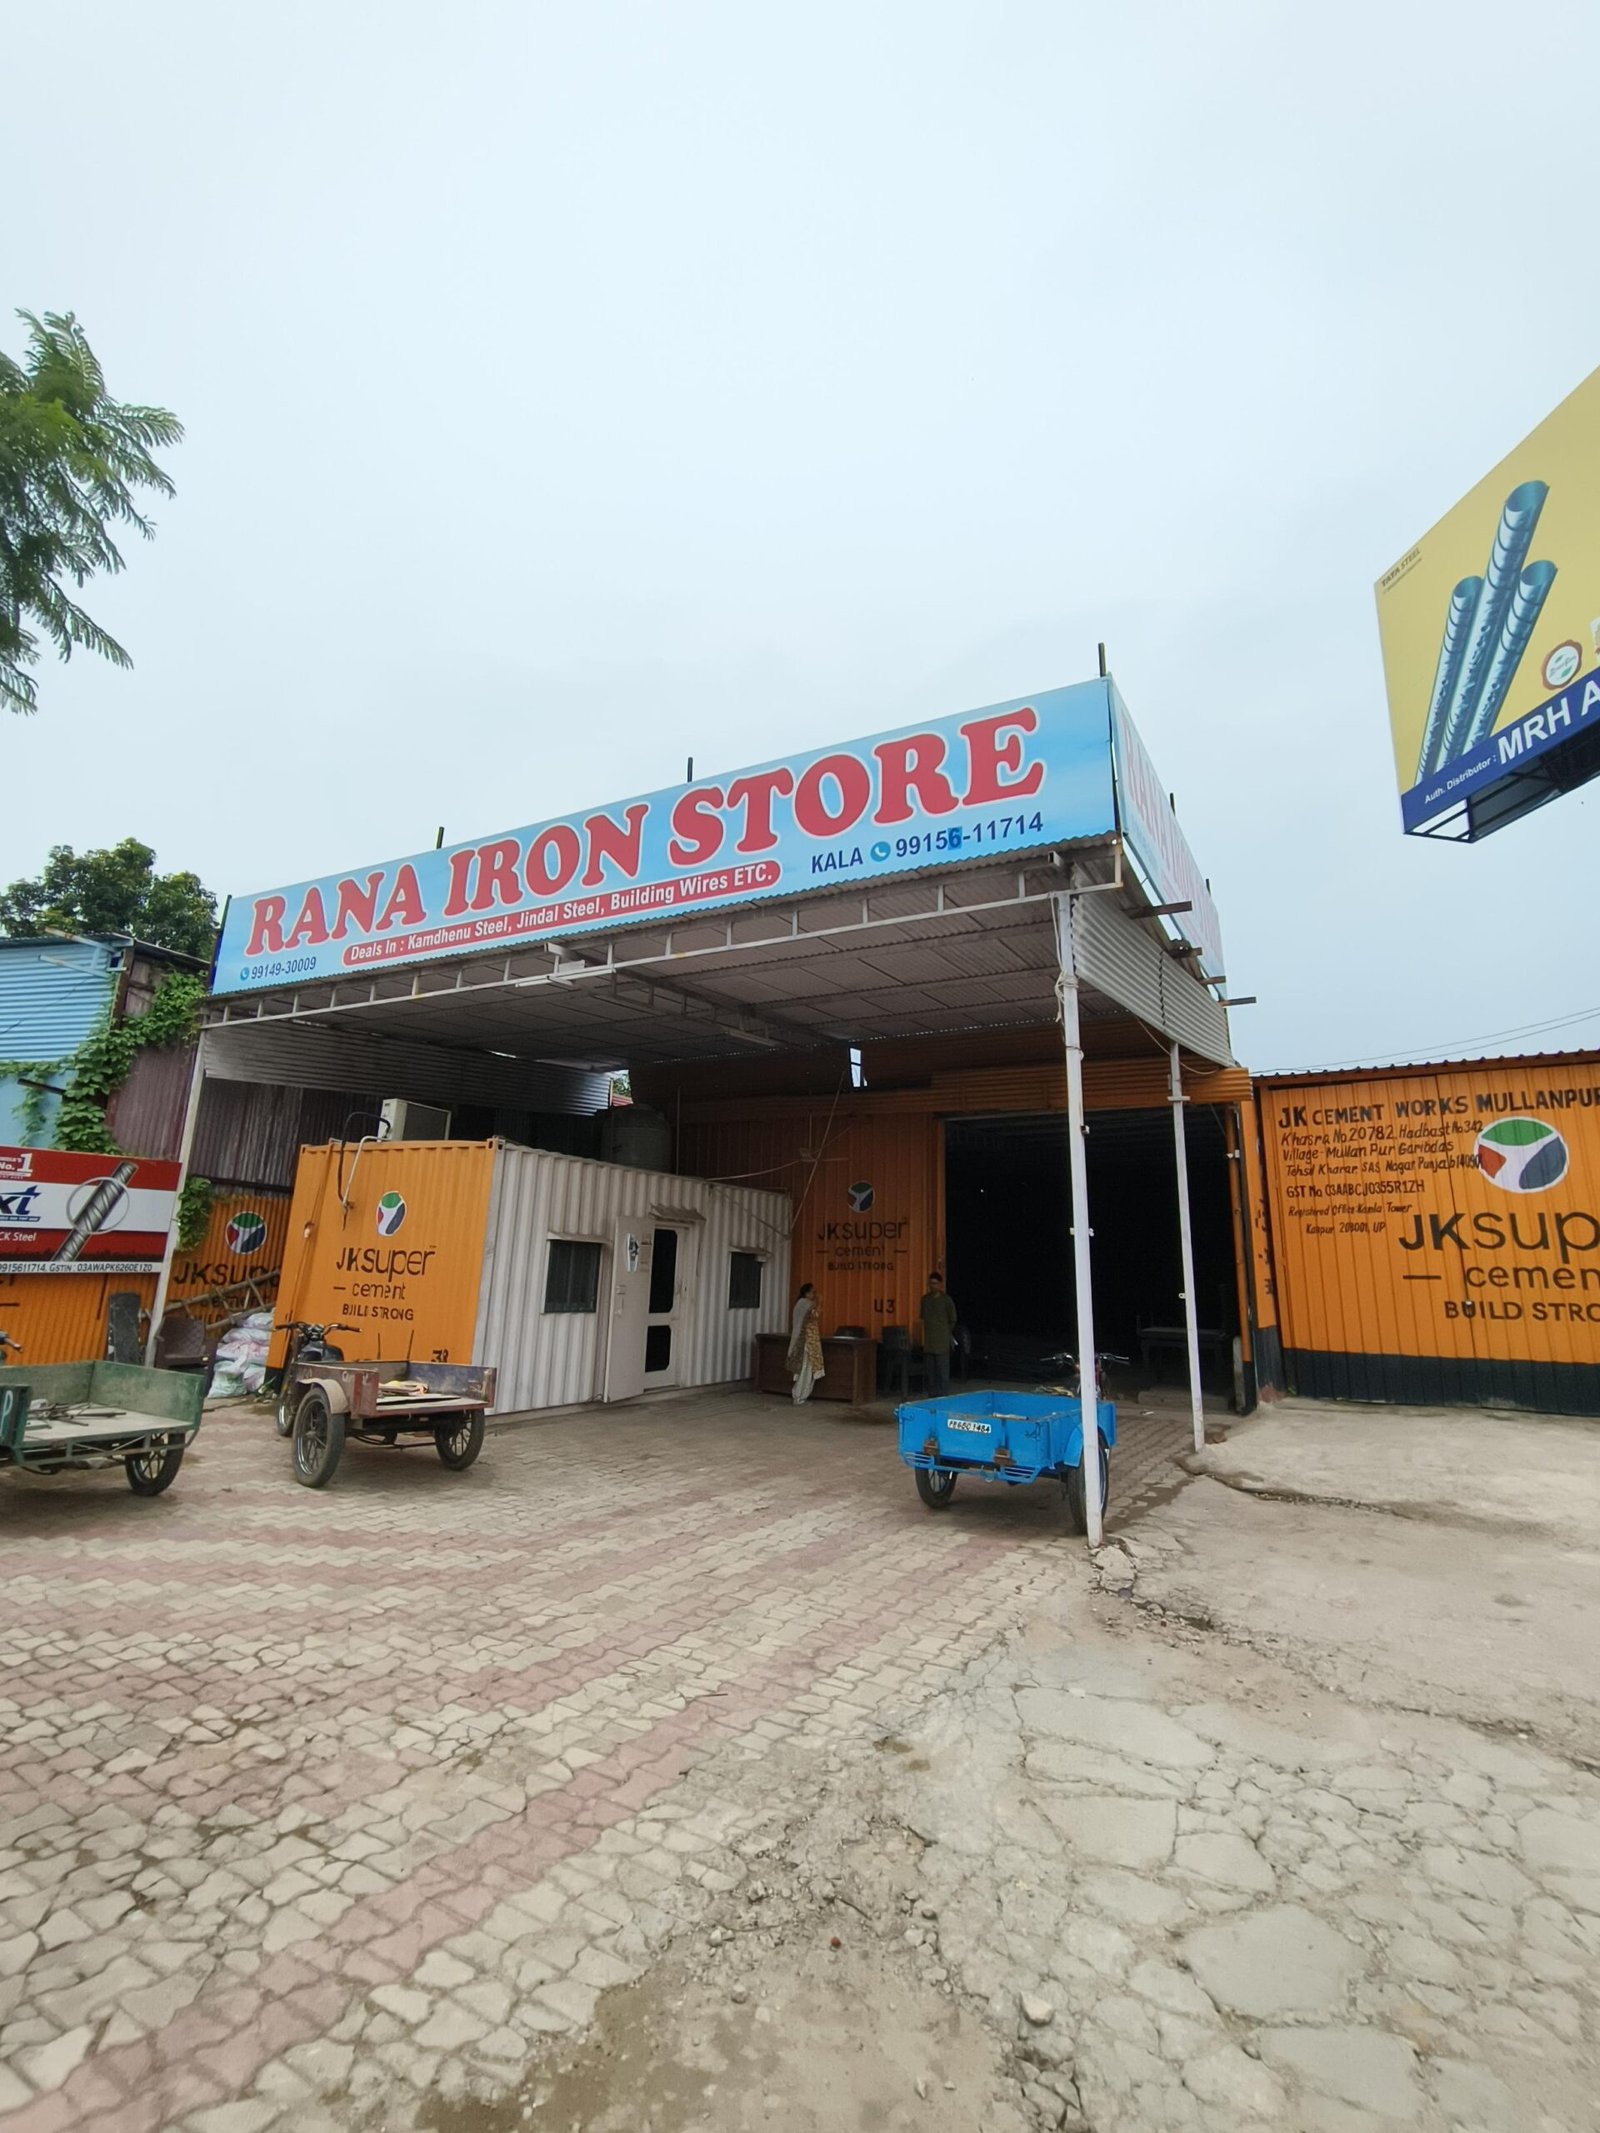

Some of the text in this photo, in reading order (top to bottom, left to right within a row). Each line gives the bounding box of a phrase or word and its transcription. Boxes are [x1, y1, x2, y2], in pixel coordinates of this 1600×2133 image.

[1425, 783, 1445, 804] Auth.
[1447, 760, 1491, 790] Distributor
[1498, 697, 1571, 765] MRH
[246, 865, 426, 955] RANA
[444, 805, 649, 916] IRON
[669, 708, 1044, 866] STORE
[812, 812, 1044, 874] KALA 99156-11714
[351, 943, 382, 961] Deals
[385, 940, 396, 954] In
[408, 927, 471, 950] Kamdhenu
[475, 917, 512, 937] Steel,
[517, 906, 558, 928] Jindal
[563, 897, 605, 920] Steel,
[611, 886, 675, 910] Building
[680, 874, 728, 897] Wires
[734, 863, 772, 887] ETC.
[251, 956, 317, 980] 99149-30009
[1278, 1105, 1308, 1129] JK
[1312, 1103, 1385, 1126] CEMENT
[1396, 1096, 1469, 1118] WORKS
[1361, 1160, 1381, 1173] SAS
[1286, 1185, 1307, 1198] GST
[13, 1231, 37, 1242] Steel
[817, 1221, 907, 1245] JKsuper
[1373, 1221, 1387, 1234] UP
[336, 1247, 436, 1283] JKsuper
[1444, 1300, 1523, 1320] BUILD
